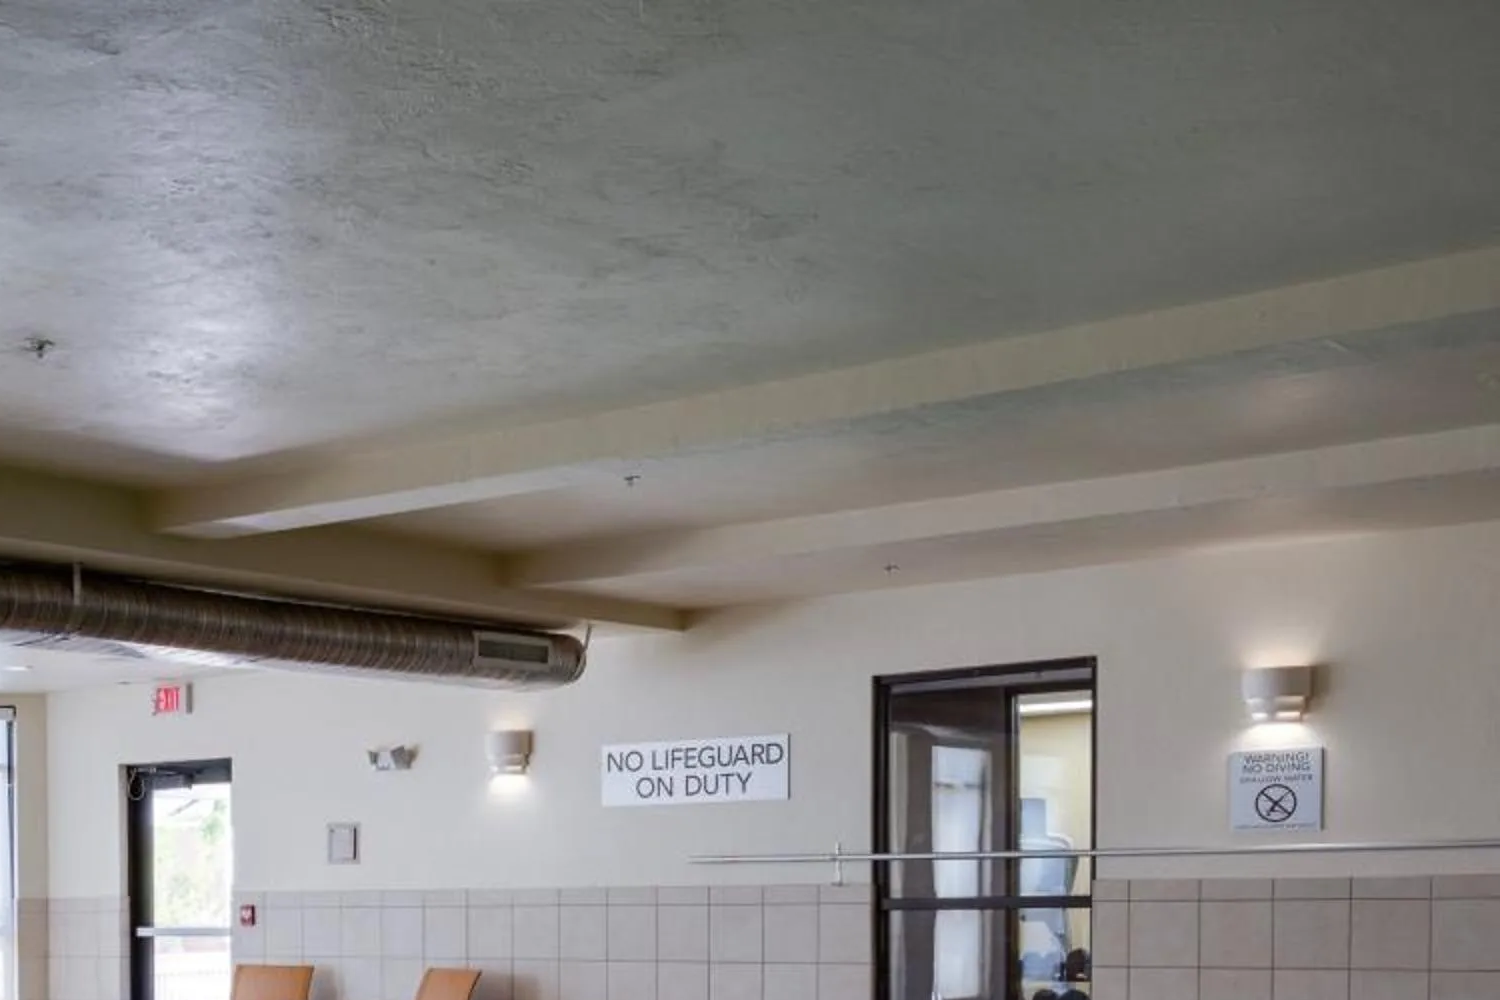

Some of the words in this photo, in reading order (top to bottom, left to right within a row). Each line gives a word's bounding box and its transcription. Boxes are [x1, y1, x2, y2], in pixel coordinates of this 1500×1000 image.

[156, 687, 180, 713] EXIT
[607, 751, 644, 772] NO
[652, 743, 785, 771] LIFEGUARD
[1243, 763, 1263, 773] NO
[1266, 761, 1311, 773] DIVING
[636, 776, 674, 798] ON
[685, 772, 753, 796] DUTY
